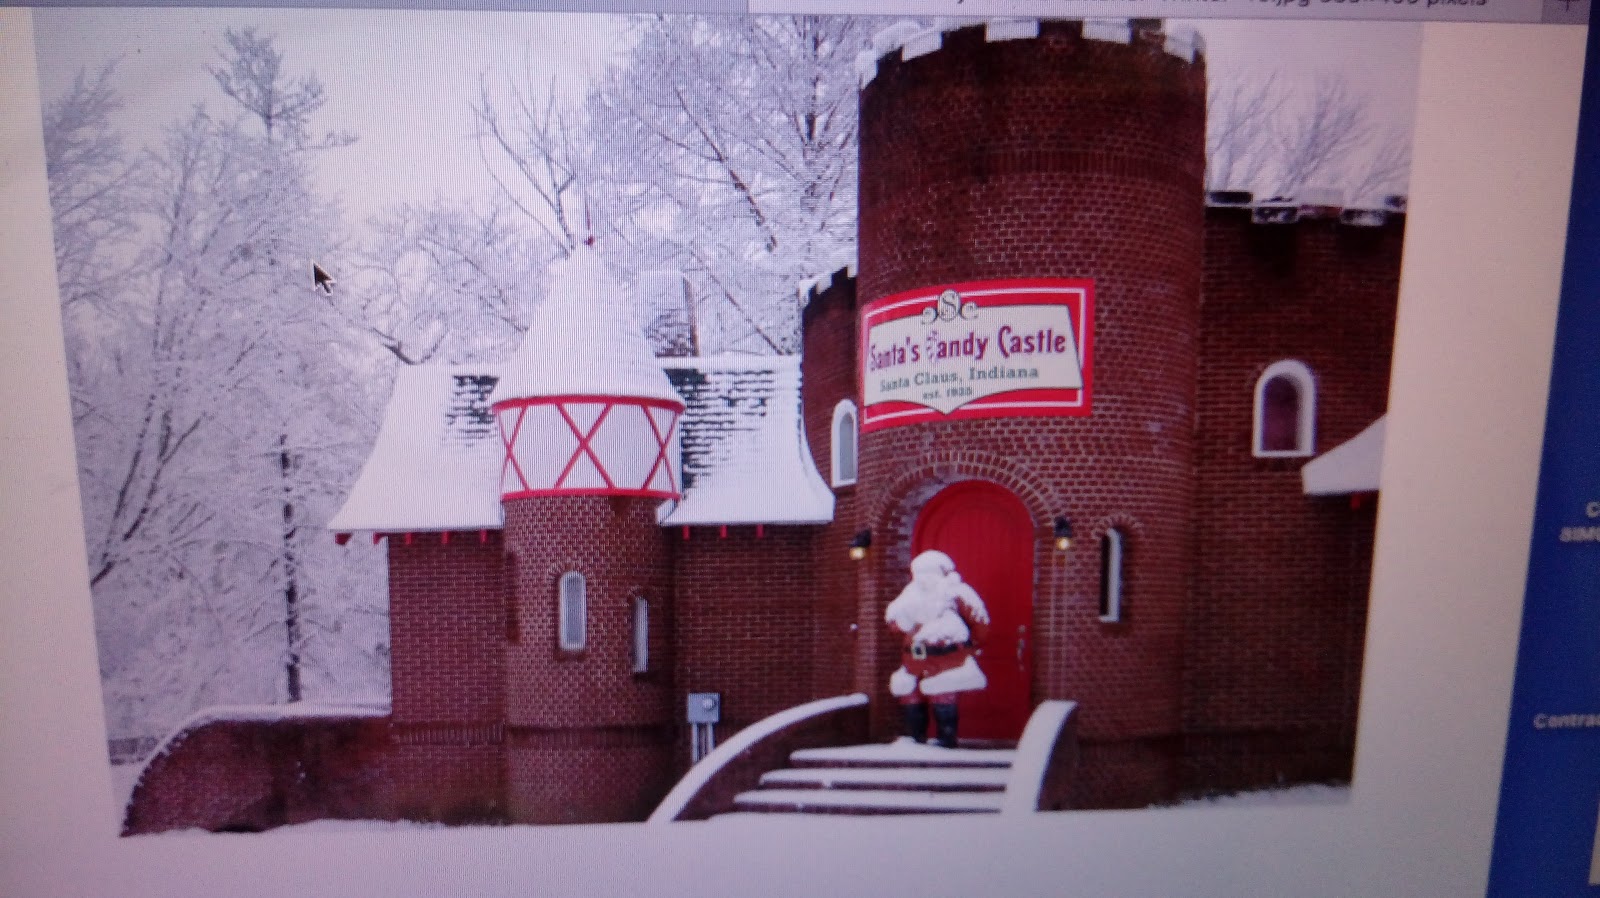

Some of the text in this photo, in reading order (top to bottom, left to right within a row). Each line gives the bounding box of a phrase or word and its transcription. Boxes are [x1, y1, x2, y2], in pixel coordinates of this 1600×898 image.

[870, 336, 920, 371] Santa's
[997, 325, 1066, 358] Castle
[879, 378, 910, 393] Santa
[968, 366, 1039, 381] Indiana
